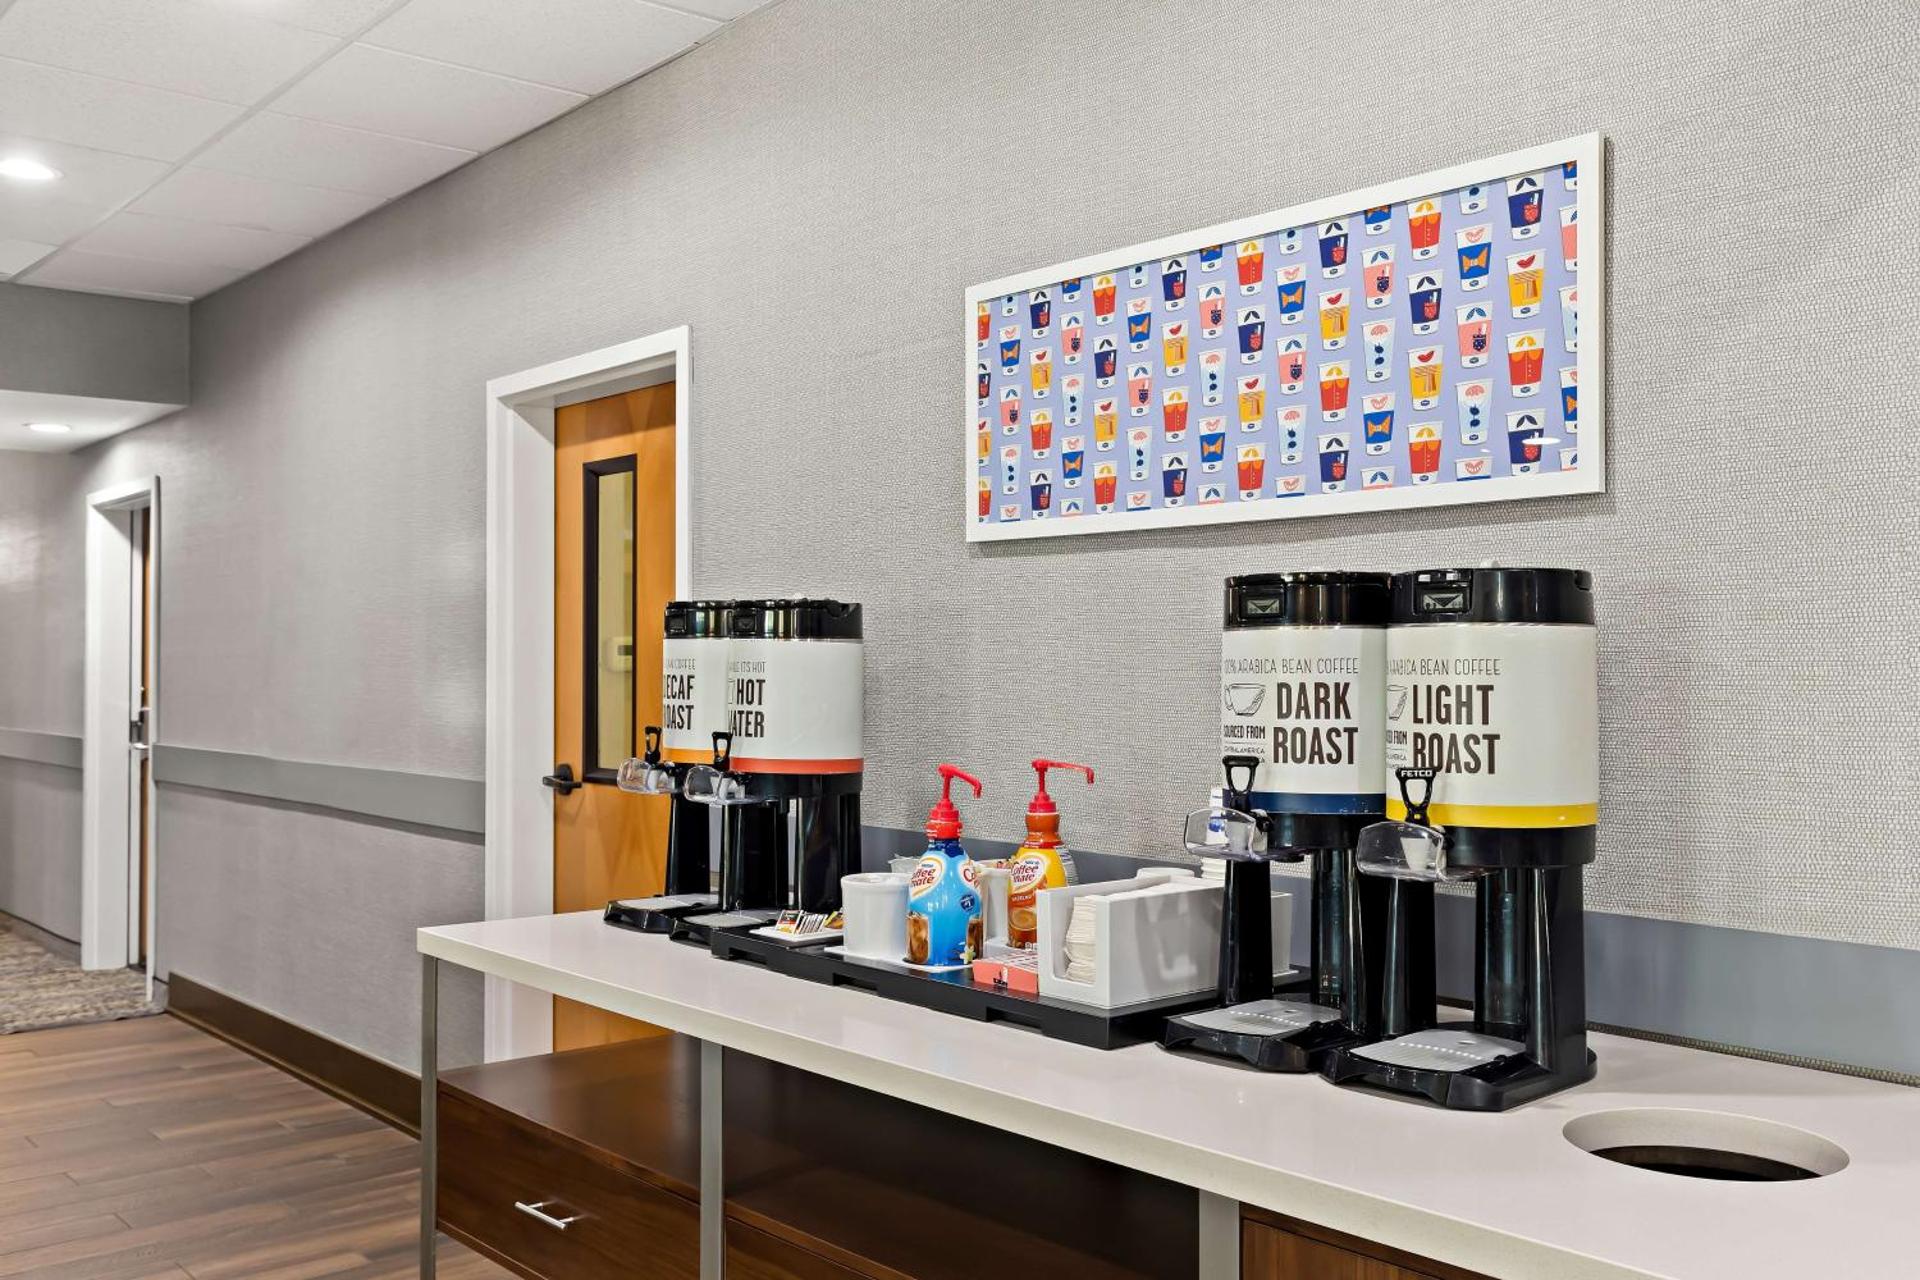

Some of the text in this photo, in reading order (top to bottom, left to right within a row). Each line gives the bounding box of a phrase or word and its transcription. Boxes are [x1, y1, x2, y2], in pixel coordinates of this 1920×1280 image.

[752, 661, 766, 673] HOT
[1237, 658, 1277, 674] ARABICA
[1282, 658, 1312, 674] BEAN
[1317, 658, 1359, 674] COFFEE
[1420, 658, 1449, 675] BEAN
[1454, 659, 1502, 675] COFFEE
[663, 674, 696, 700] ECAF
[736, 678, 766, 706] HOT
[1276, 682, 1352, 720] DARK
[1412, 684, 1495, 726] LIGHT
[663, 704, 695, 731] OAST
[1246, 725, 1266, 739] FROM
[1273, 727, 1359, 765] ROAST
[1412, 731, 1501, 775] ROAST
[1401, 769, 1434, 777] FETCO
